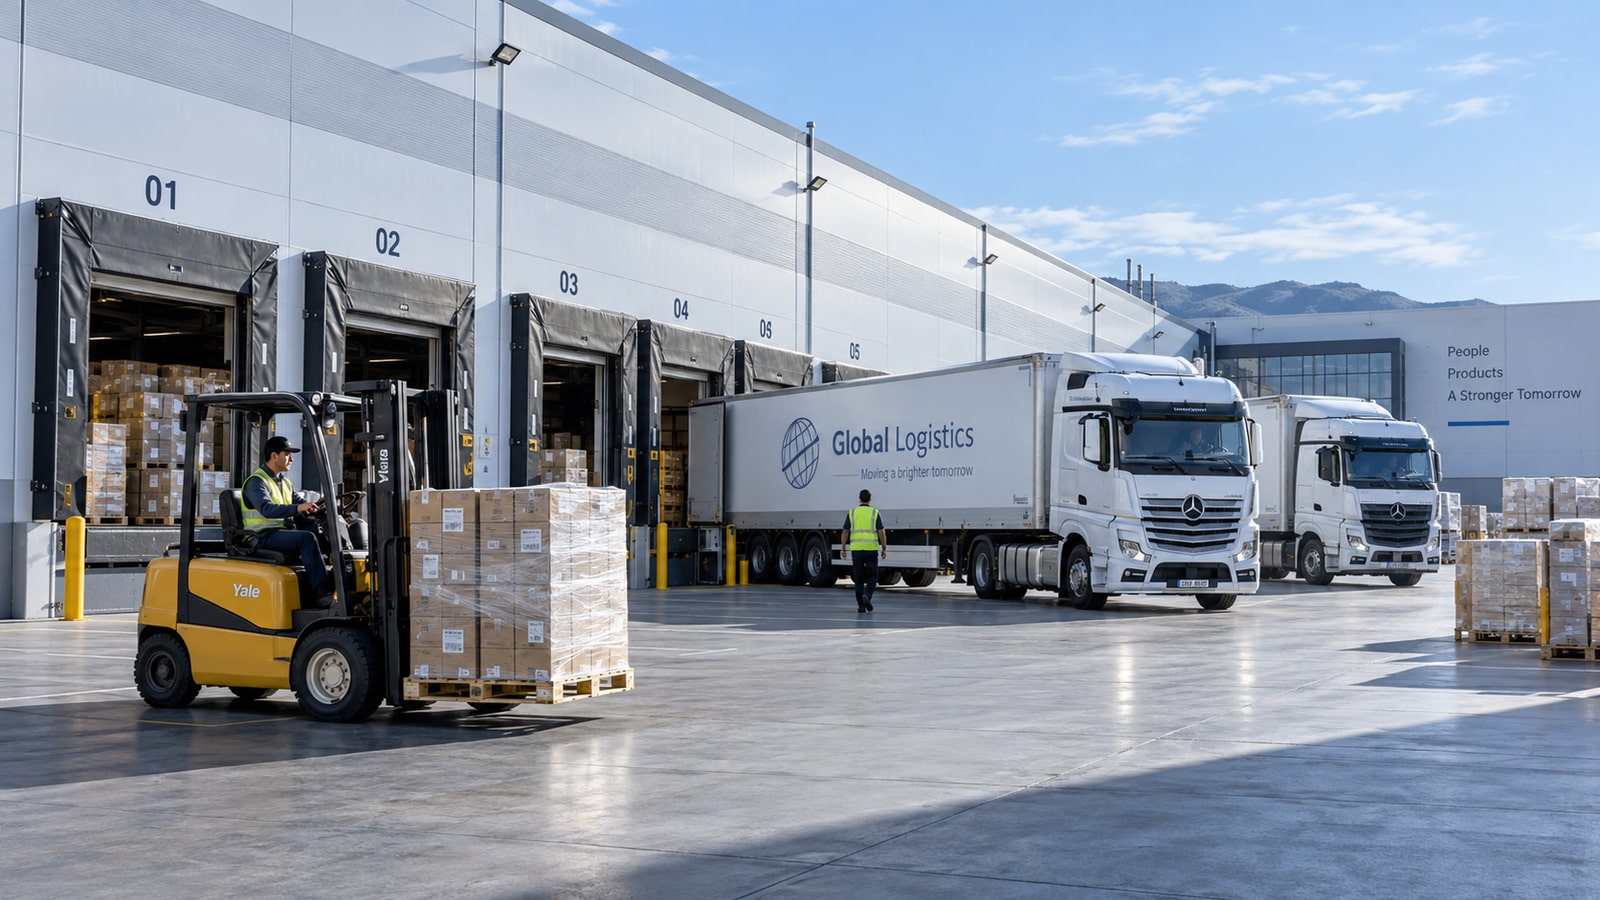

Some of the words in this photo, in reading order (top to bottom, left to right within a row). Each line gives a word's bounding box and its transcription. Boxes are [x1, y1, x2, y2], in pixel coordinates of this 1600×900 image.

[145, 175, 176, 210] 01
[375, 228, 400, 257] 02
[559, 270, 579, 295] 03
[673, 298, 689, 320] 04
[1448, 345, 1490, 359] People
[1448, 367, 1504, 379] Products
[1447, 390, 1457, 402] A
[1460, 389, 1514, 403] Stronger
[1517, 388, 1582, 400] Tomorrow
[832, 426, 889, 456] Global
[896, 422, 974, 458] Logistics
[860, 468, 889, 482] Moving
[890, 469, 896, 479] a
[897, 466, 930, 482] brighter
[931, 466, 974, 478] tomorrow
[233, 583, 260, 598] Yale
